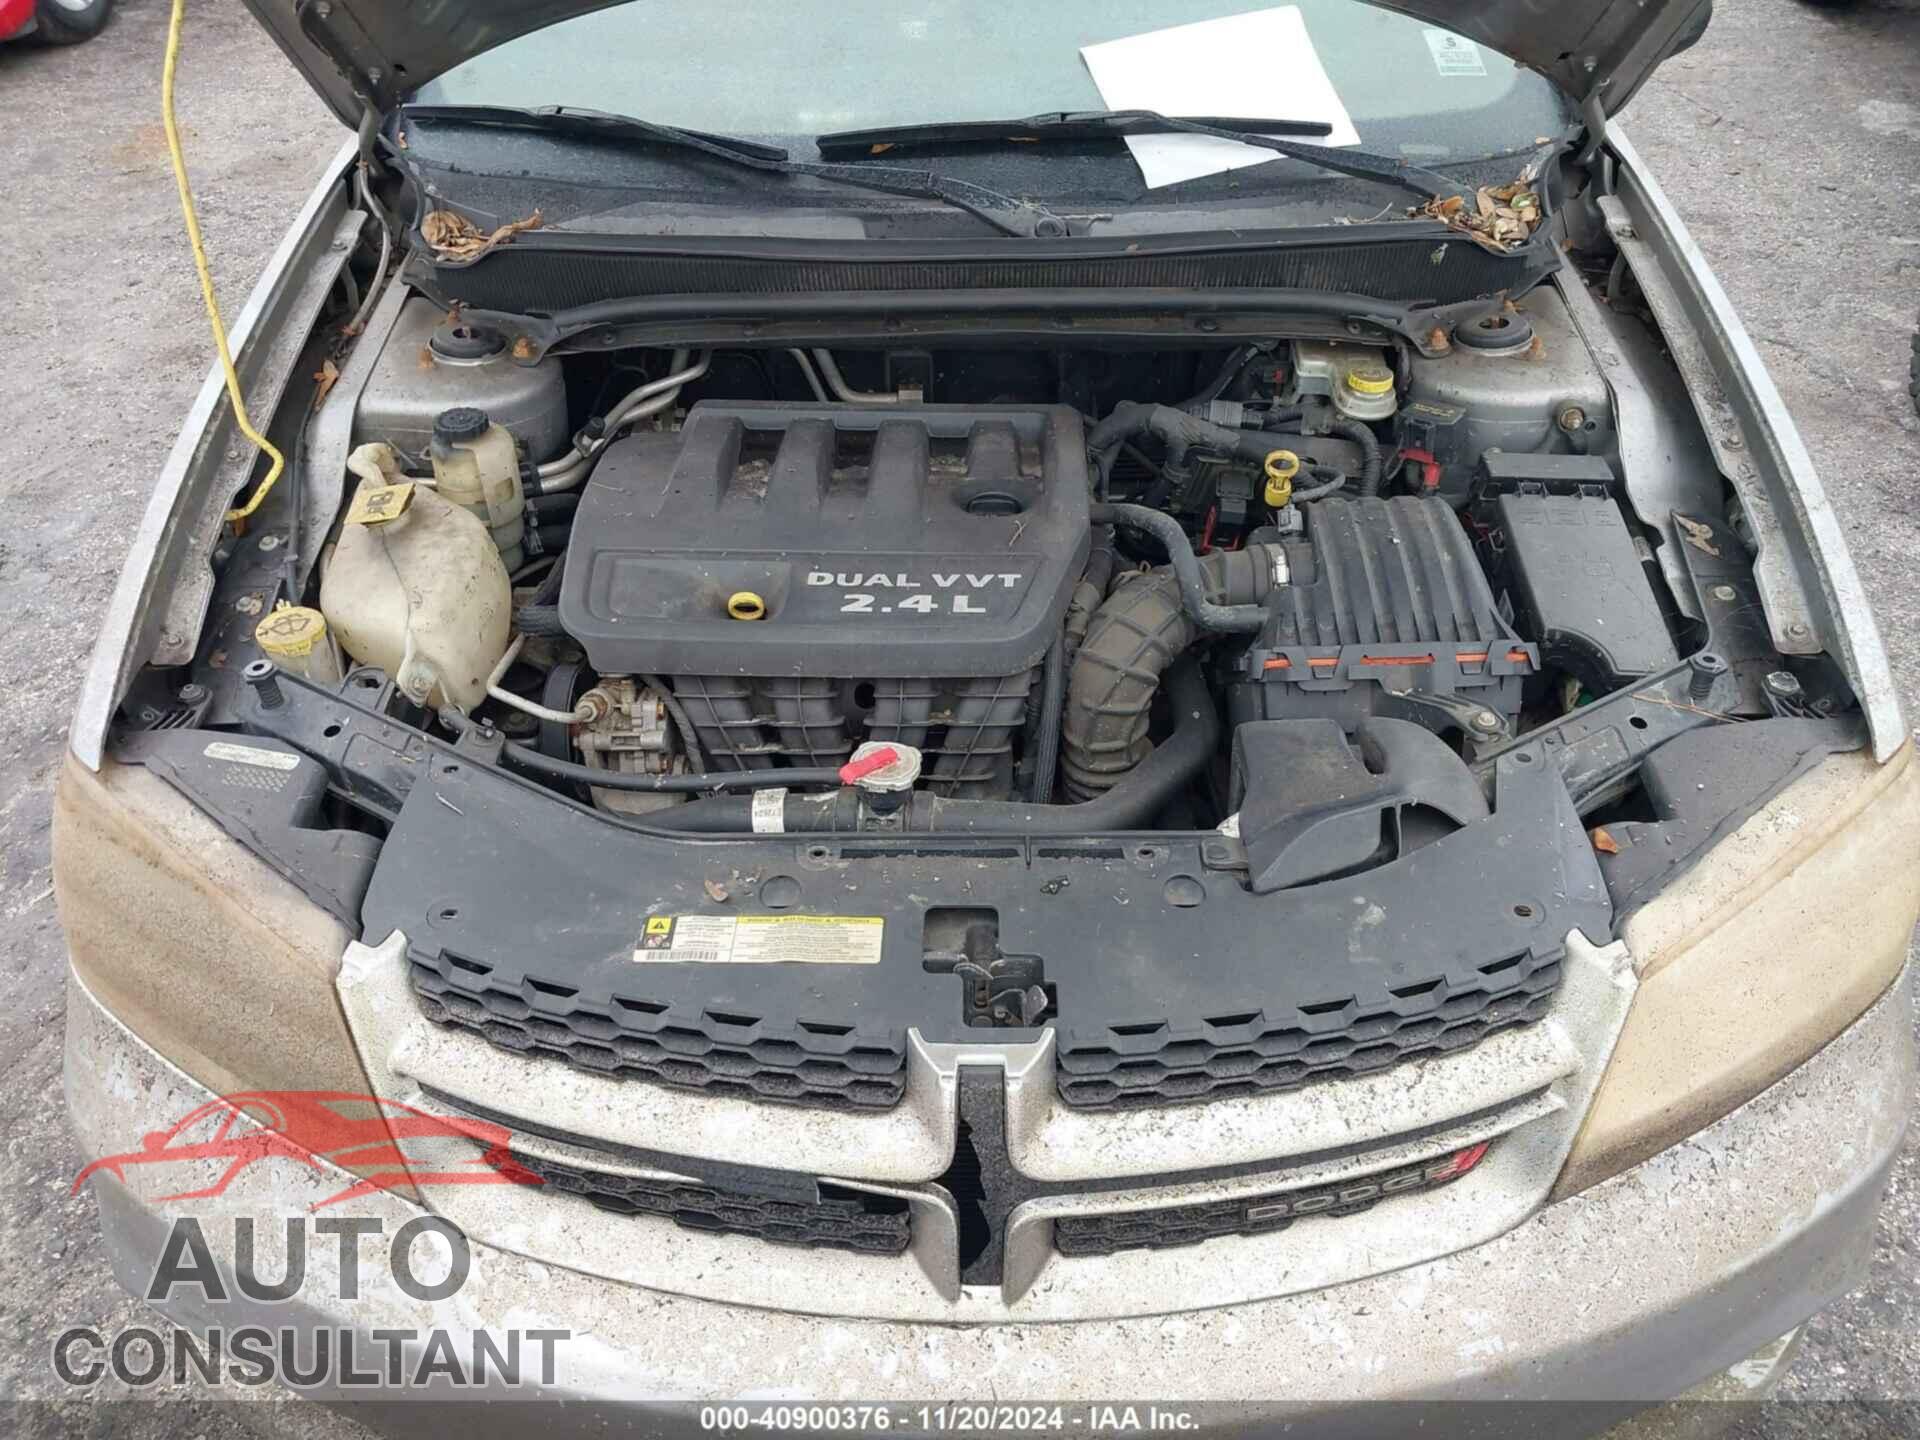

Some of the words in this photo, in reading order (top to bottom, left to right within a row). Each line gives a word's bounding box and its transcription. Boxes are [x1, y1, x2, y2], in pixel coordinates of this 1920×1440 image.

[807, 571, 921, 588] DUAL
[931, 573, 1022, 588] VVT
[840, 593, 938, 613] 2.4
[953, 594, 986, 613] L
